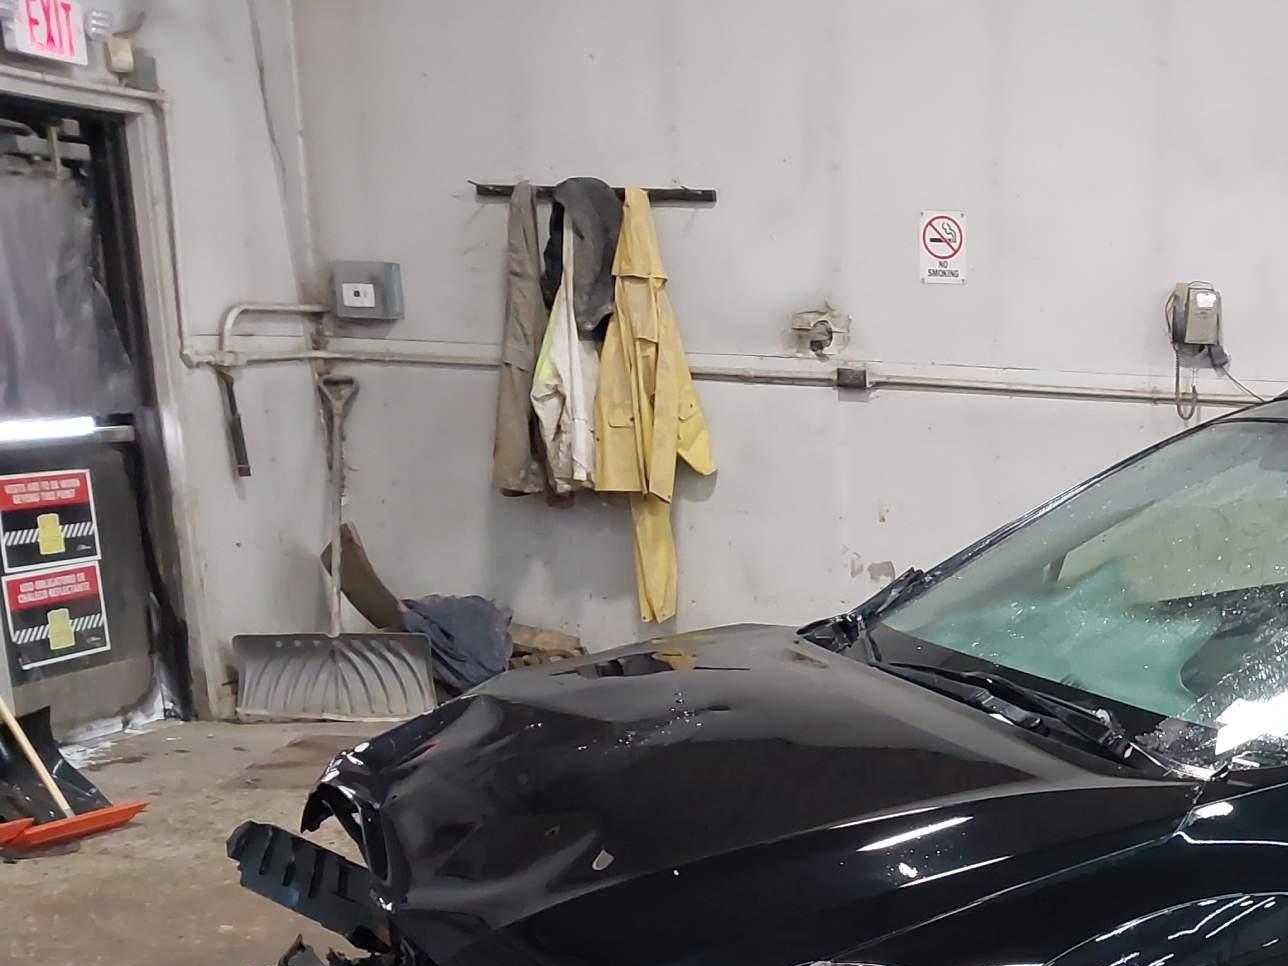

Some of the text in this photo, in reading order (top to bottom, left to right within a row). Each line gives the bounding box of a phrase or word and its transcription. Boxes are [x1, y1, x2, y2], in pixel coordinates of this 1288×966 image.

[24, 0, 76, 57] EXIT
[938, 260, 949, 268] NO
[927, 268, 959, 277] SMOKING
